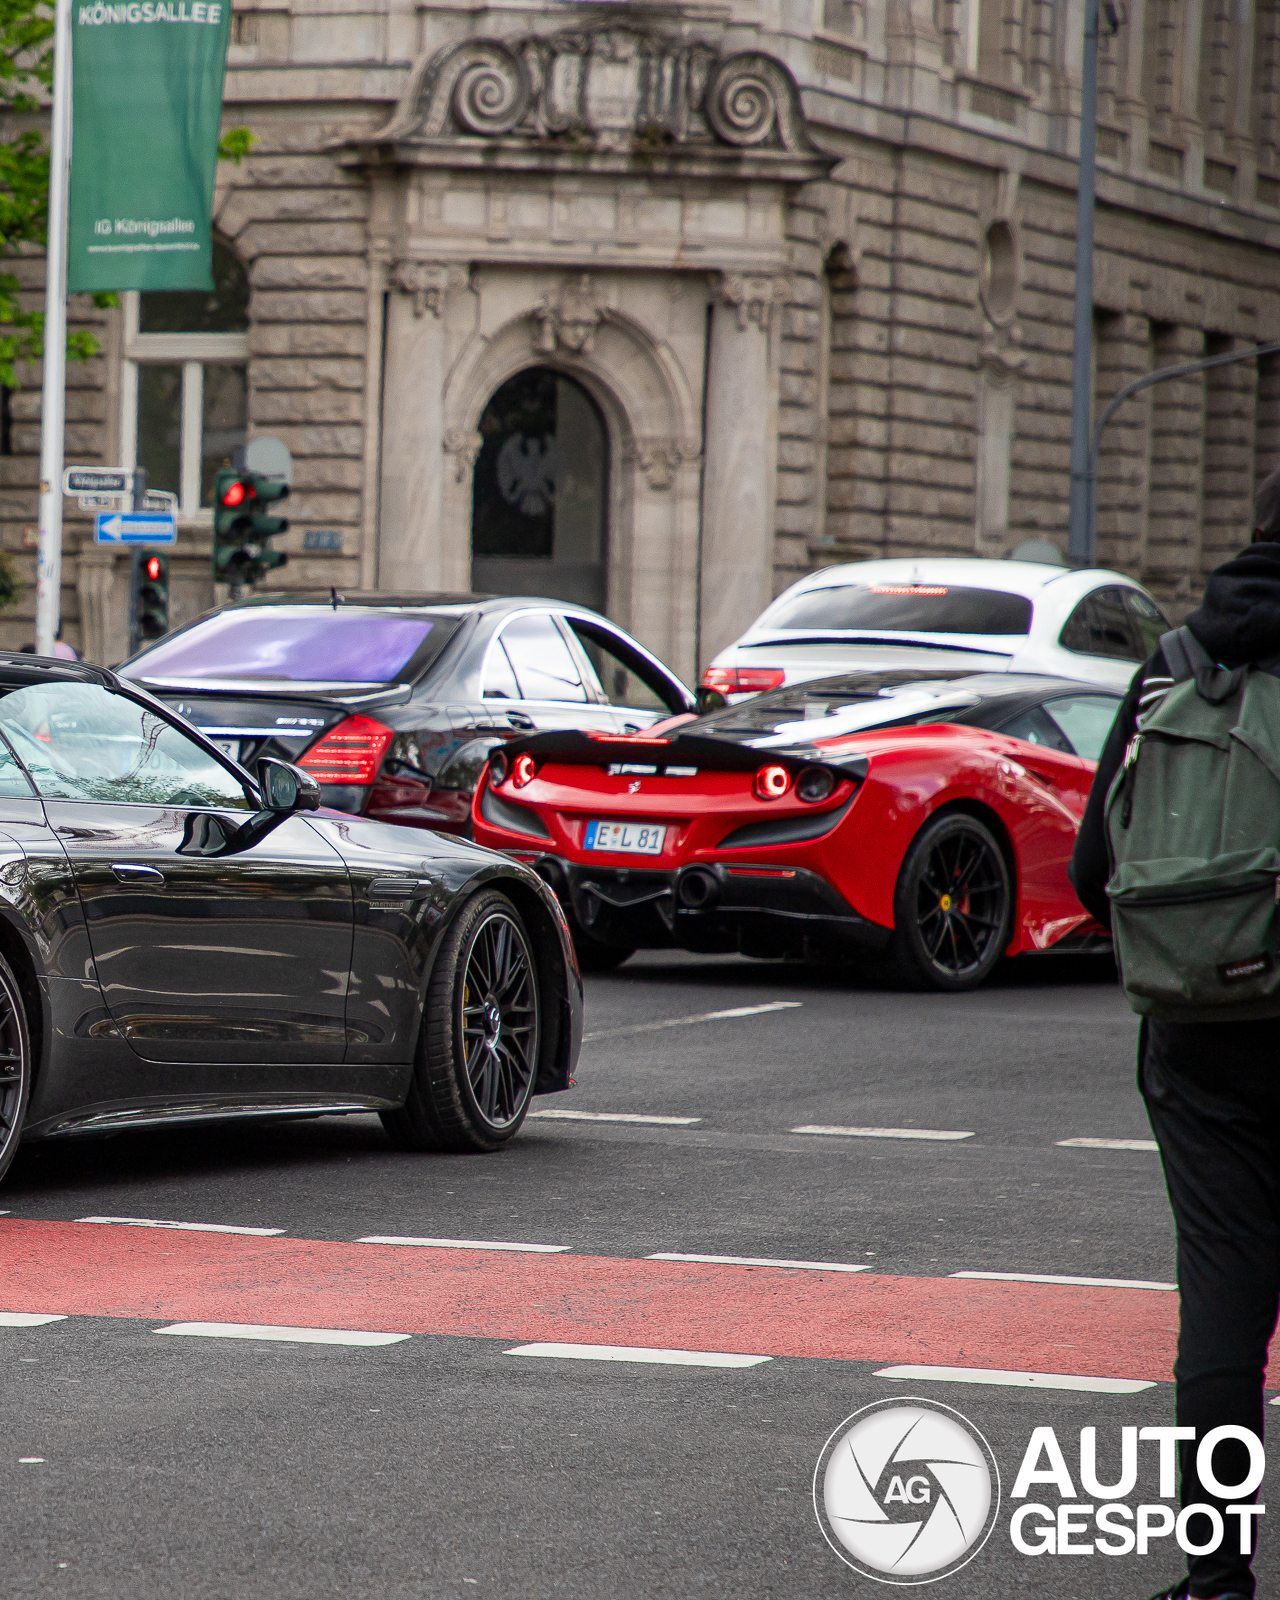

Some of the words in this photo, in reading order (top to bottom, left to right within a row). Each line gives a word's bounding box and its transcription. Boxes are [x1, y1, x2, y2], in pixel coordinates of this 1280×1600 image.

[78, 1, 220, 25] KÖNIGSALLEE
[94, 219, 112, 235] IG
[597, 826, 610, 846] E
[621, 827, 631, 847] L
[638, 829, 660, 849] 81
